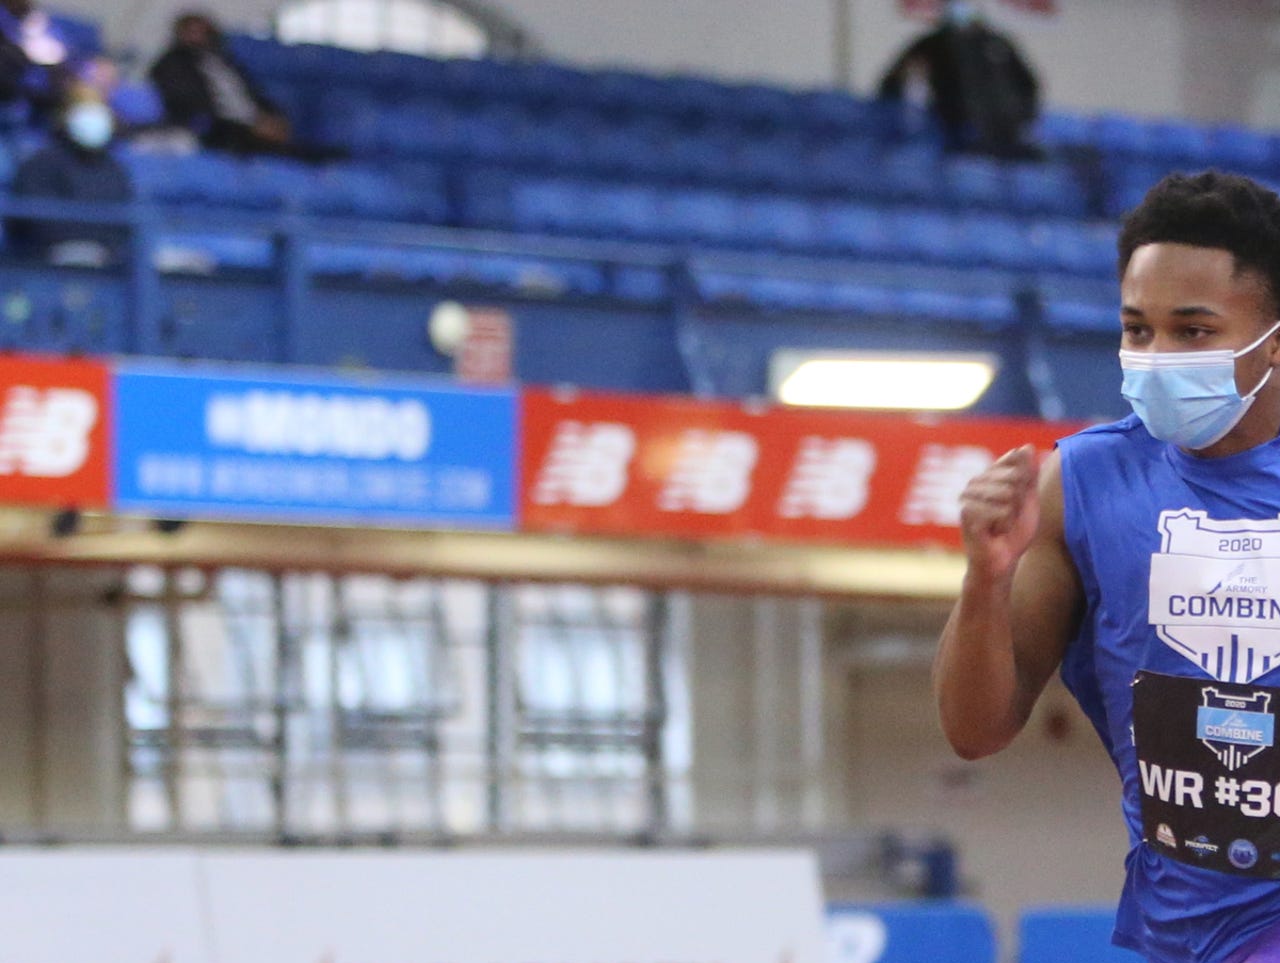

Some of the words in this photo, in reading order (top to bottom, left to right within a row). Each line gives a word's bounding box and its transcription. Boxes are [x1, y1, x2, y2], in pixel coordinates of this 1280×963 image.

[1218, 538, 1263, 552] 2020
[1239, 576, 1257, 584] THE
[1225, 585, 1268, 594] ARMORY
[1205, 725, 1264, 742] COMBINE
[1138, 759, 1204, 808] WR
